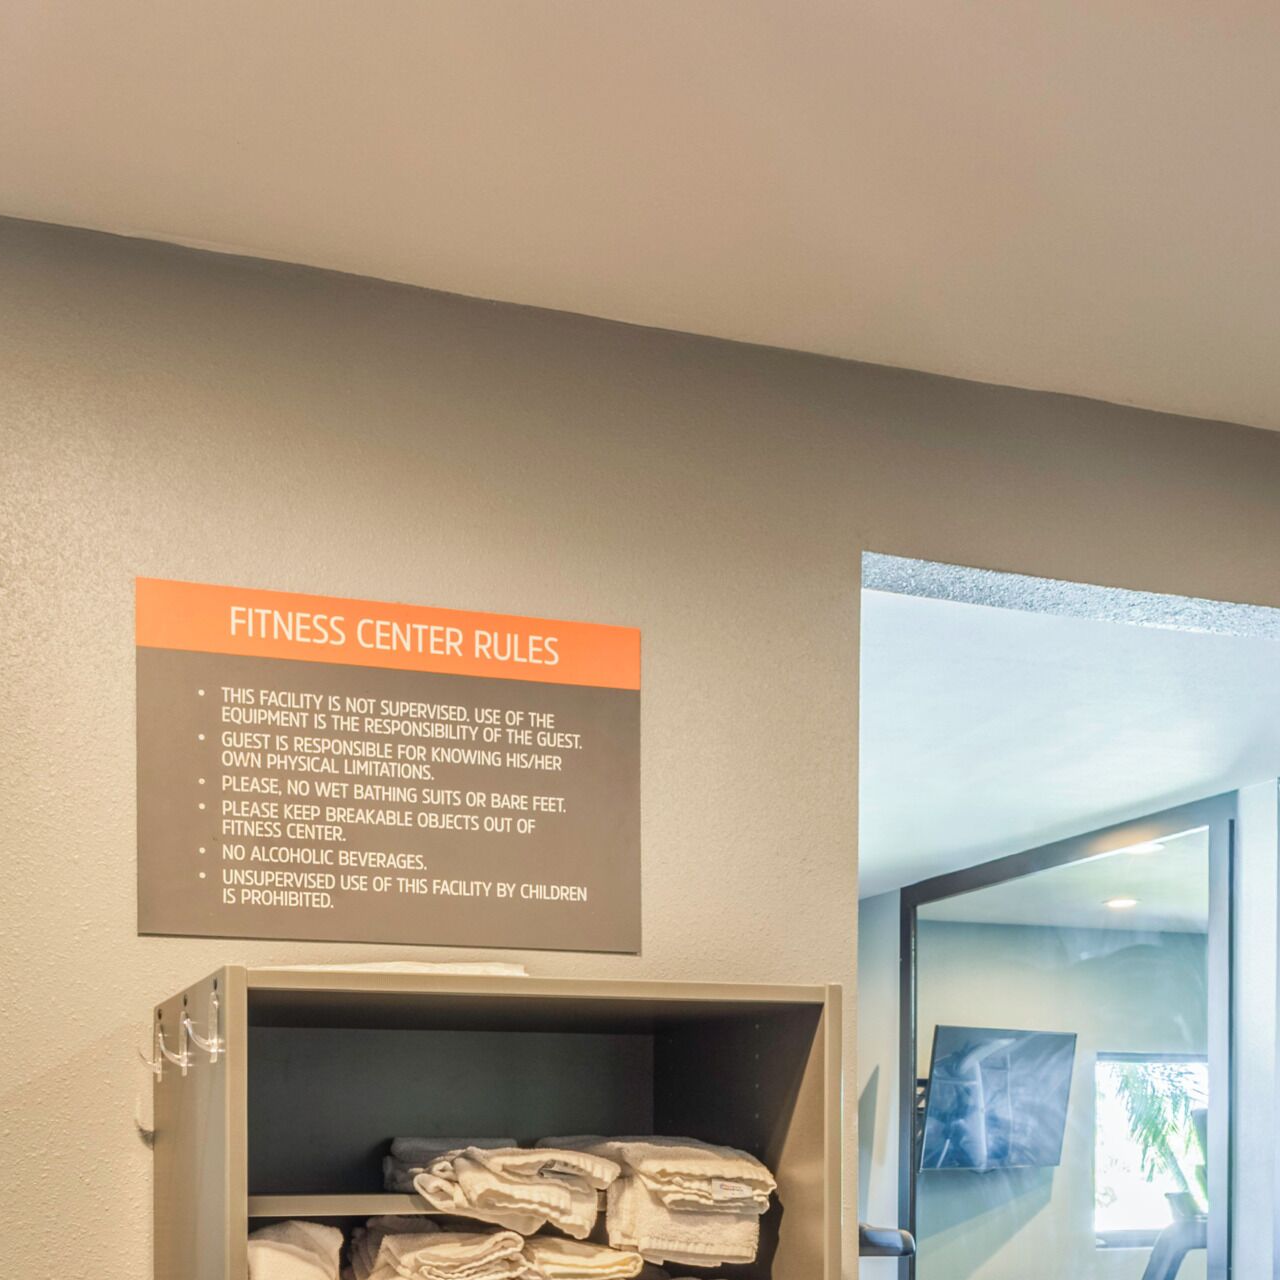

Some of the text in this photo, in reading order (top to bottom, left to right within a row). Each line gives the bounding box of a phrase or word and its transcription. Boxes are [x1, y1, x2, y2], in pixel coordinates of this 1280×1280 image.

[230, 605, 558, 665] FITNESS CENTER RULES
[222, 686, 554, 728] THIS FACILITY IS NOT SUPERVISED. USE OF THE
[223, 706, 582, 749] EQUIPMENT IS THE RESPONSIBILITY OF THE GUEST.
[223, 730, 561, 770] GUEST IS RESPONSIBLE FOR KNOWING HIS/HER
[223, 750, 434, 780] OWN PHYSICAL LIMITATIONS.
[223, 774, 566, 812] PLEASE, NO WET BATHING SUITS OR BARE FEET.
[223, 799, 535, 833] PLEASE KEEP BREAKABLE OBJECTS OUT OF
[223, 818, 346, 841] FITNESS CENTER.
[223, 843, 427, 870] NO ALCOHOLIC BEVERAGES.
[223, 868, 587, 901] UNSUPERVISED USE OF THIS FACILITY BY CHILDREN
[223, 887, 333, 908] IS PROHIBITED.
